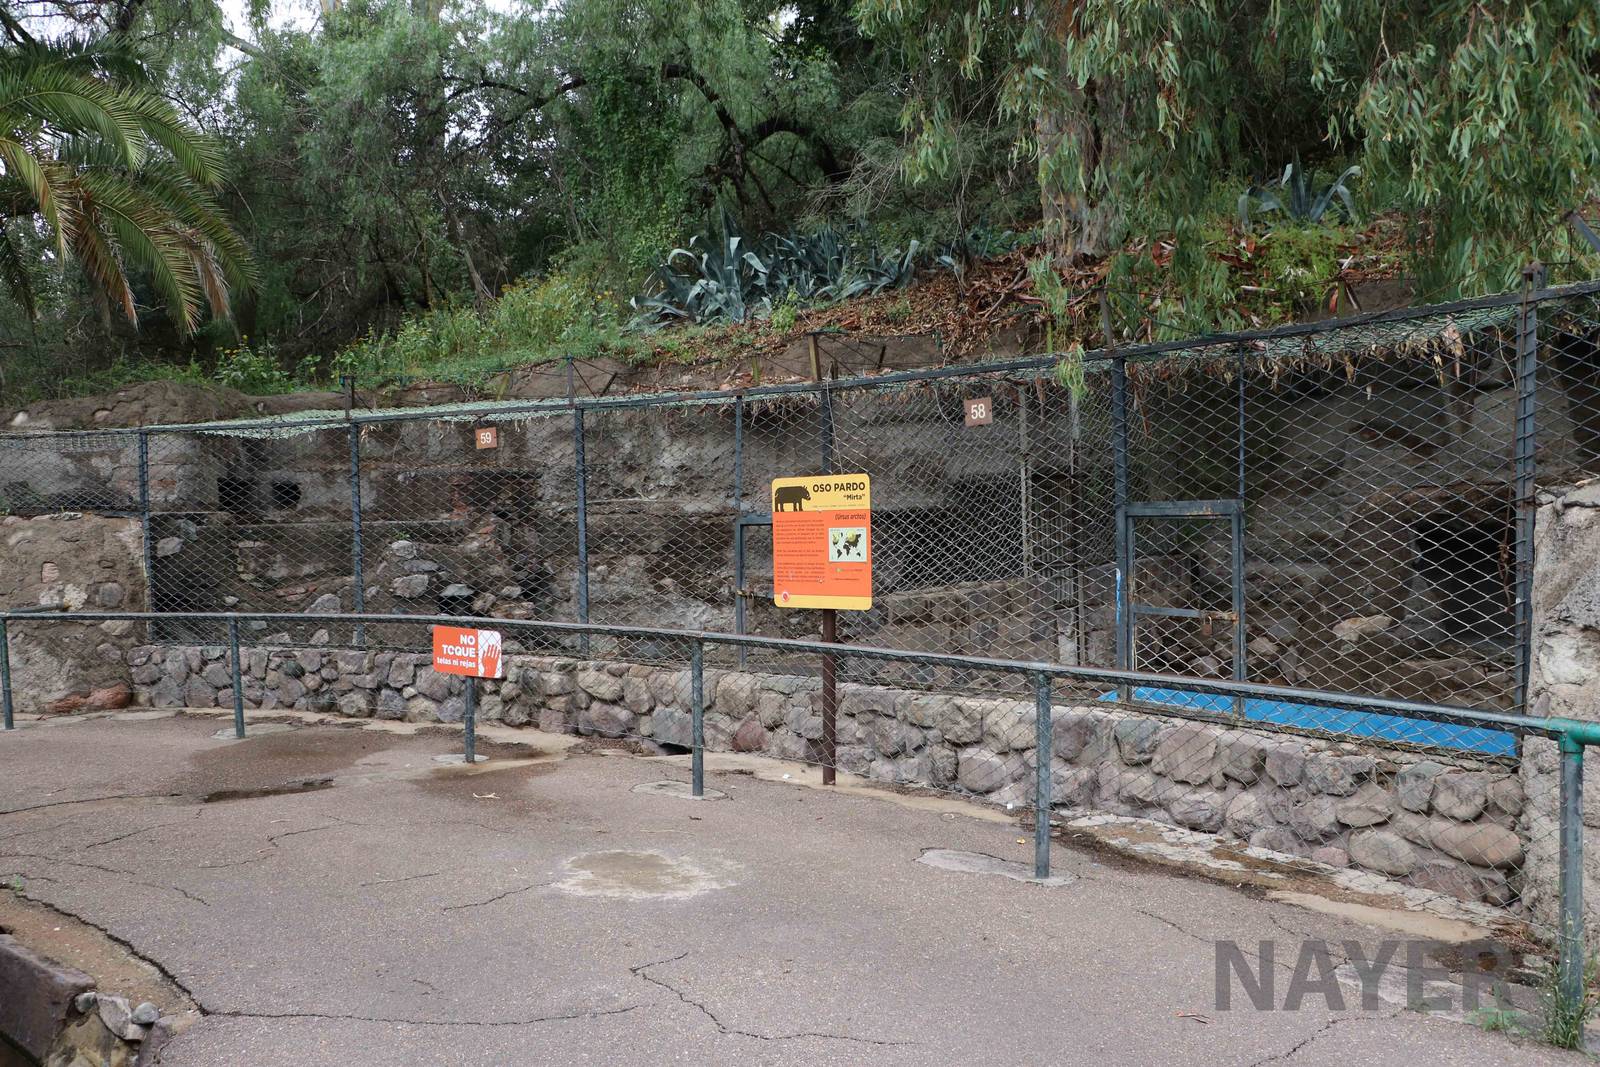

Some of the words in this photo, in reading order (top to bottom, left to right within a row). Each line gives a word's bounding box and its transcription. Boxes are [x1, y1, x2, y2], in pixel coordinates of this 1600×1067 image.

[971, 403, 986, 420] 58
[480, 431, 492, 444] 59
[812, 484, 832, 493] OSO
[834, 482, 866, 492] PARDO
[460, 634, 476, 645] NO
[436, 656, 452, 665] telas
[452, 658, 459, 666] ni
[459, 660, 476, 669] rejas
